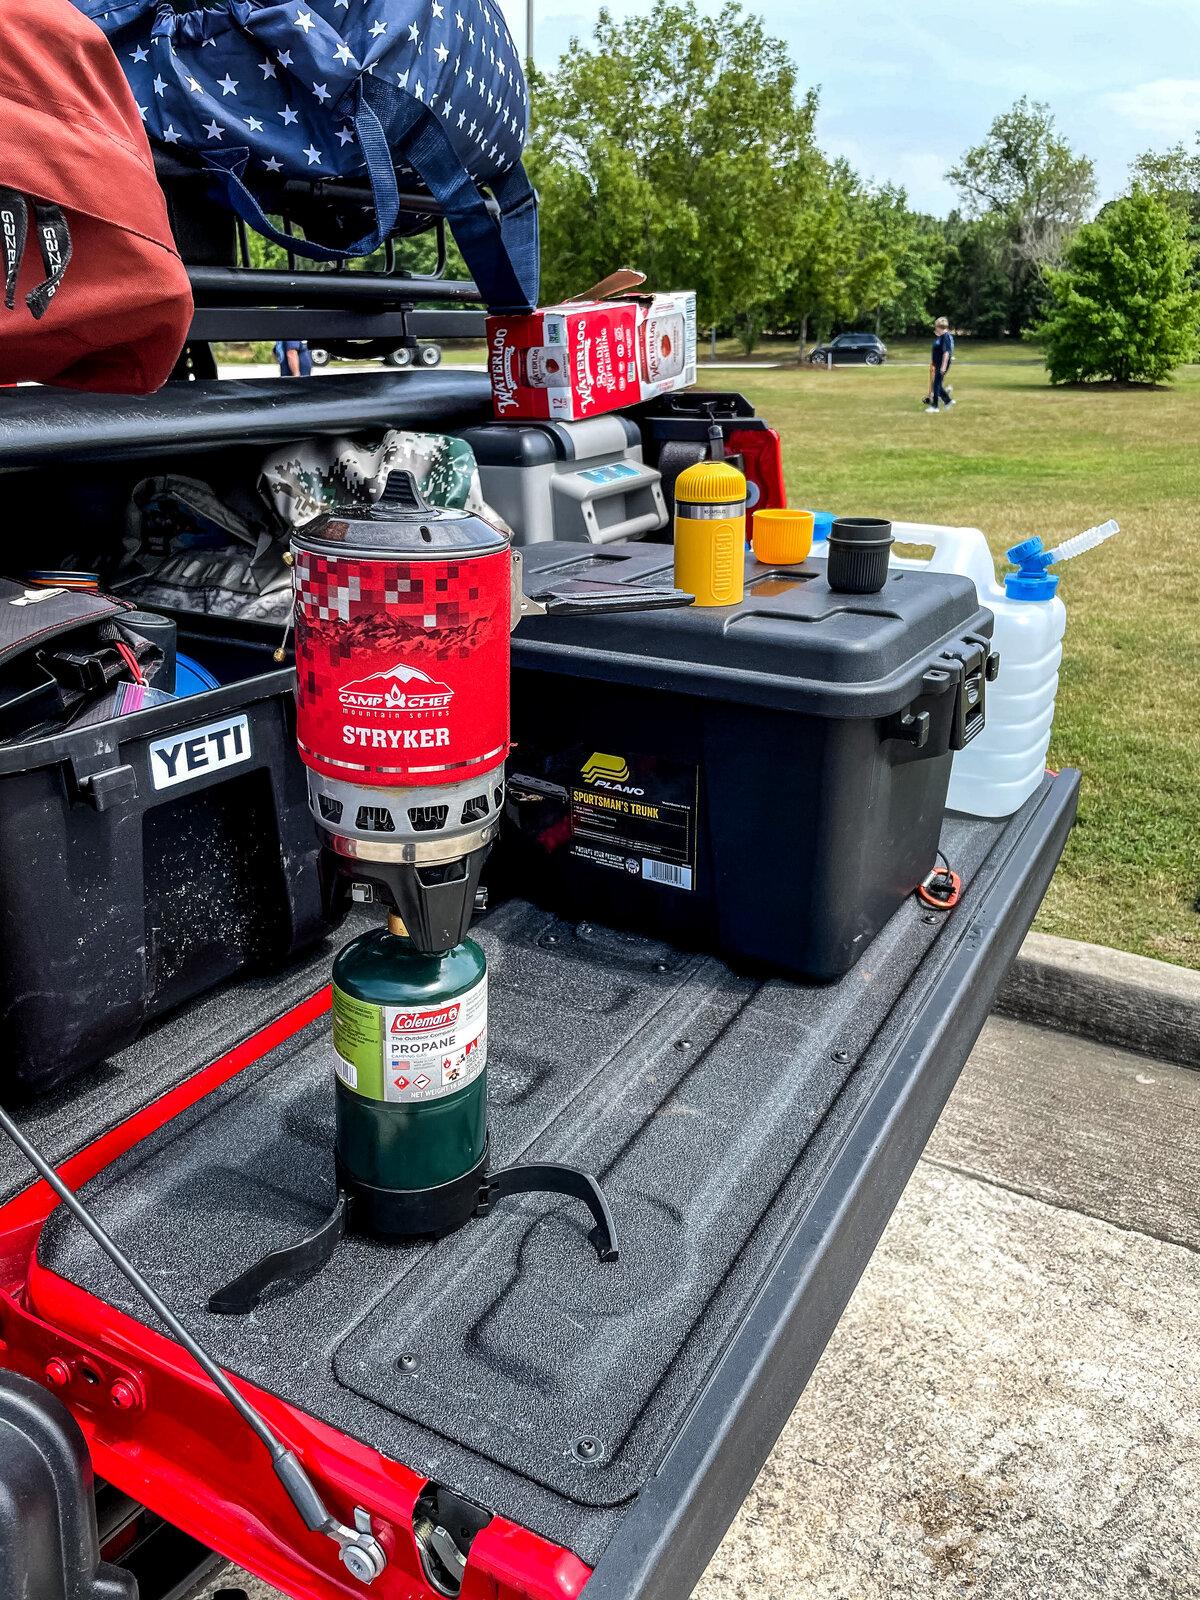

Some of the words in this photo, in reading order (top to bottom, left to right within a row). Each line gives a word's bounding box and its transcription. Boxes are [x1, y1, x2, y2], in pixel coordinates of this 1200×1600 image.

[601, 328, 616, 393] REFRESHING
[649, 321, 660, 378] WATERLOO
[492, 328, 519, 414] WATERLOO
[529, 348, 544, 386] WATERLOO
[576, 320, 595, 414] WATERLOO
[595, 337, 608, 388] BOLDLY
[553, 398, 562, 409] 12
[339, 694, 383, 707] CAMP
[407, 695, 453, 707] CHEF
[342, 708, 400, 718] mountain
[410, 710, 450, 718] series
[343, 725, 450, 748] STRYKER
[155, 724, 243, 778] YETI
[594, 779, 645, 796] PLANO
[573, 791, 629, 814] SPORTSMAN'S
[630, 803, 659, 819] TRUNK
[396, 1012, 447, 1029] Coleman
[391, 1035, 456, 1054] PROPANE
[425, 1085, 449, 1096] WEIGHT
